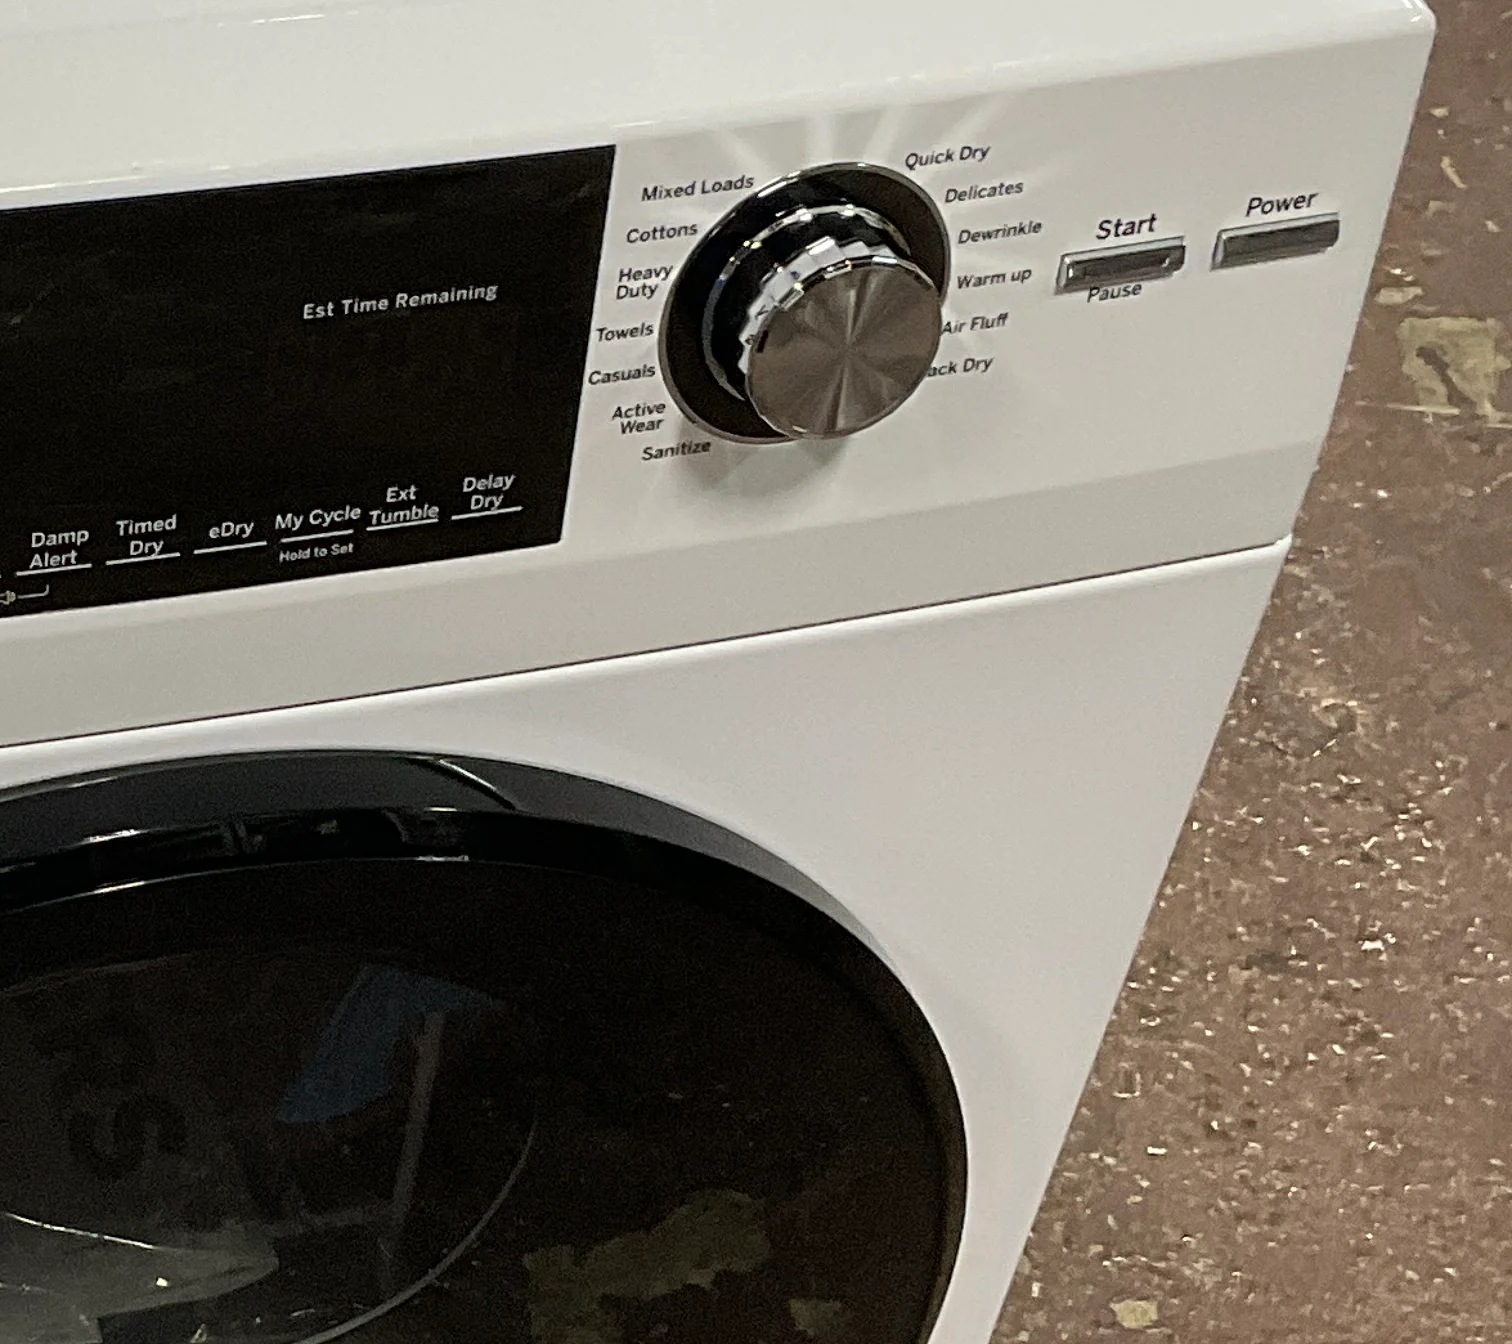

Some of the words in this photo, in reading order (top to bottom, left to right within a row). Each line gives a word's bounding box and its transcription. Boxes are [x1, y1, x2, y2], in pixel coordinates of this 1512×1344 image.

[904, 148, 956, 171] Quick
[959, 145, 992, 162] Dry
[641, 180, 696, 202] Mixed
[700, 174, 756, 195] Loads
[945, 182, 1025, 204] Delicates
[1245, 192, 1320, 218] Power
[626, 223, 699, 244] Cottons
[958, 220, 1043, 244] Dewrinkle
[1095, 212, 1157, 241] Start
[618, 264, 674, 283] Heavy
[956, 272, 1007, 290] Warm
[1010, 268, 1033, 284] up
[303, 301, 335, 320] Est
[340, 297, 389, 315] Time
[395, 284, 499, 309] Remaining
[615, 282, 659, 300] Duty
[1086, 282, 1143, 303] Pause
[595, 321, 655, 342] Towels
[941, 321, 967, 336] Air
[969, 311, 1009, 332] Fluff
[588, 363, 657, 386] Casuals
[928, 360, 957, 378] ack
[962, 356, 995, 374] Dry
[611, 401, 667, 421] Active
[619, 417, 665, 436] Wear
[641, 439, 712, 462] Sanitize
[385, 484, 418, 504] Ext
[462, 473, 517, 494] Delay
[471, 493, 505, 512] Dry
[116, 513, 178, 537] Timed
[274, 513, 304, 531] My
[308, 504, 362, 528] Cycle
[369, 503, 440, 527] Tumble
[30, 528, 90, 549] Damp
[208, 520, 255, 540] eDry
[28, 549, 79, 570] Alert
[129, 539, 165, 558] Dry
[278, 547, 311, 564] Hold
[313, 546, 328, 558] to
[330, 542, 355, 556] Set
